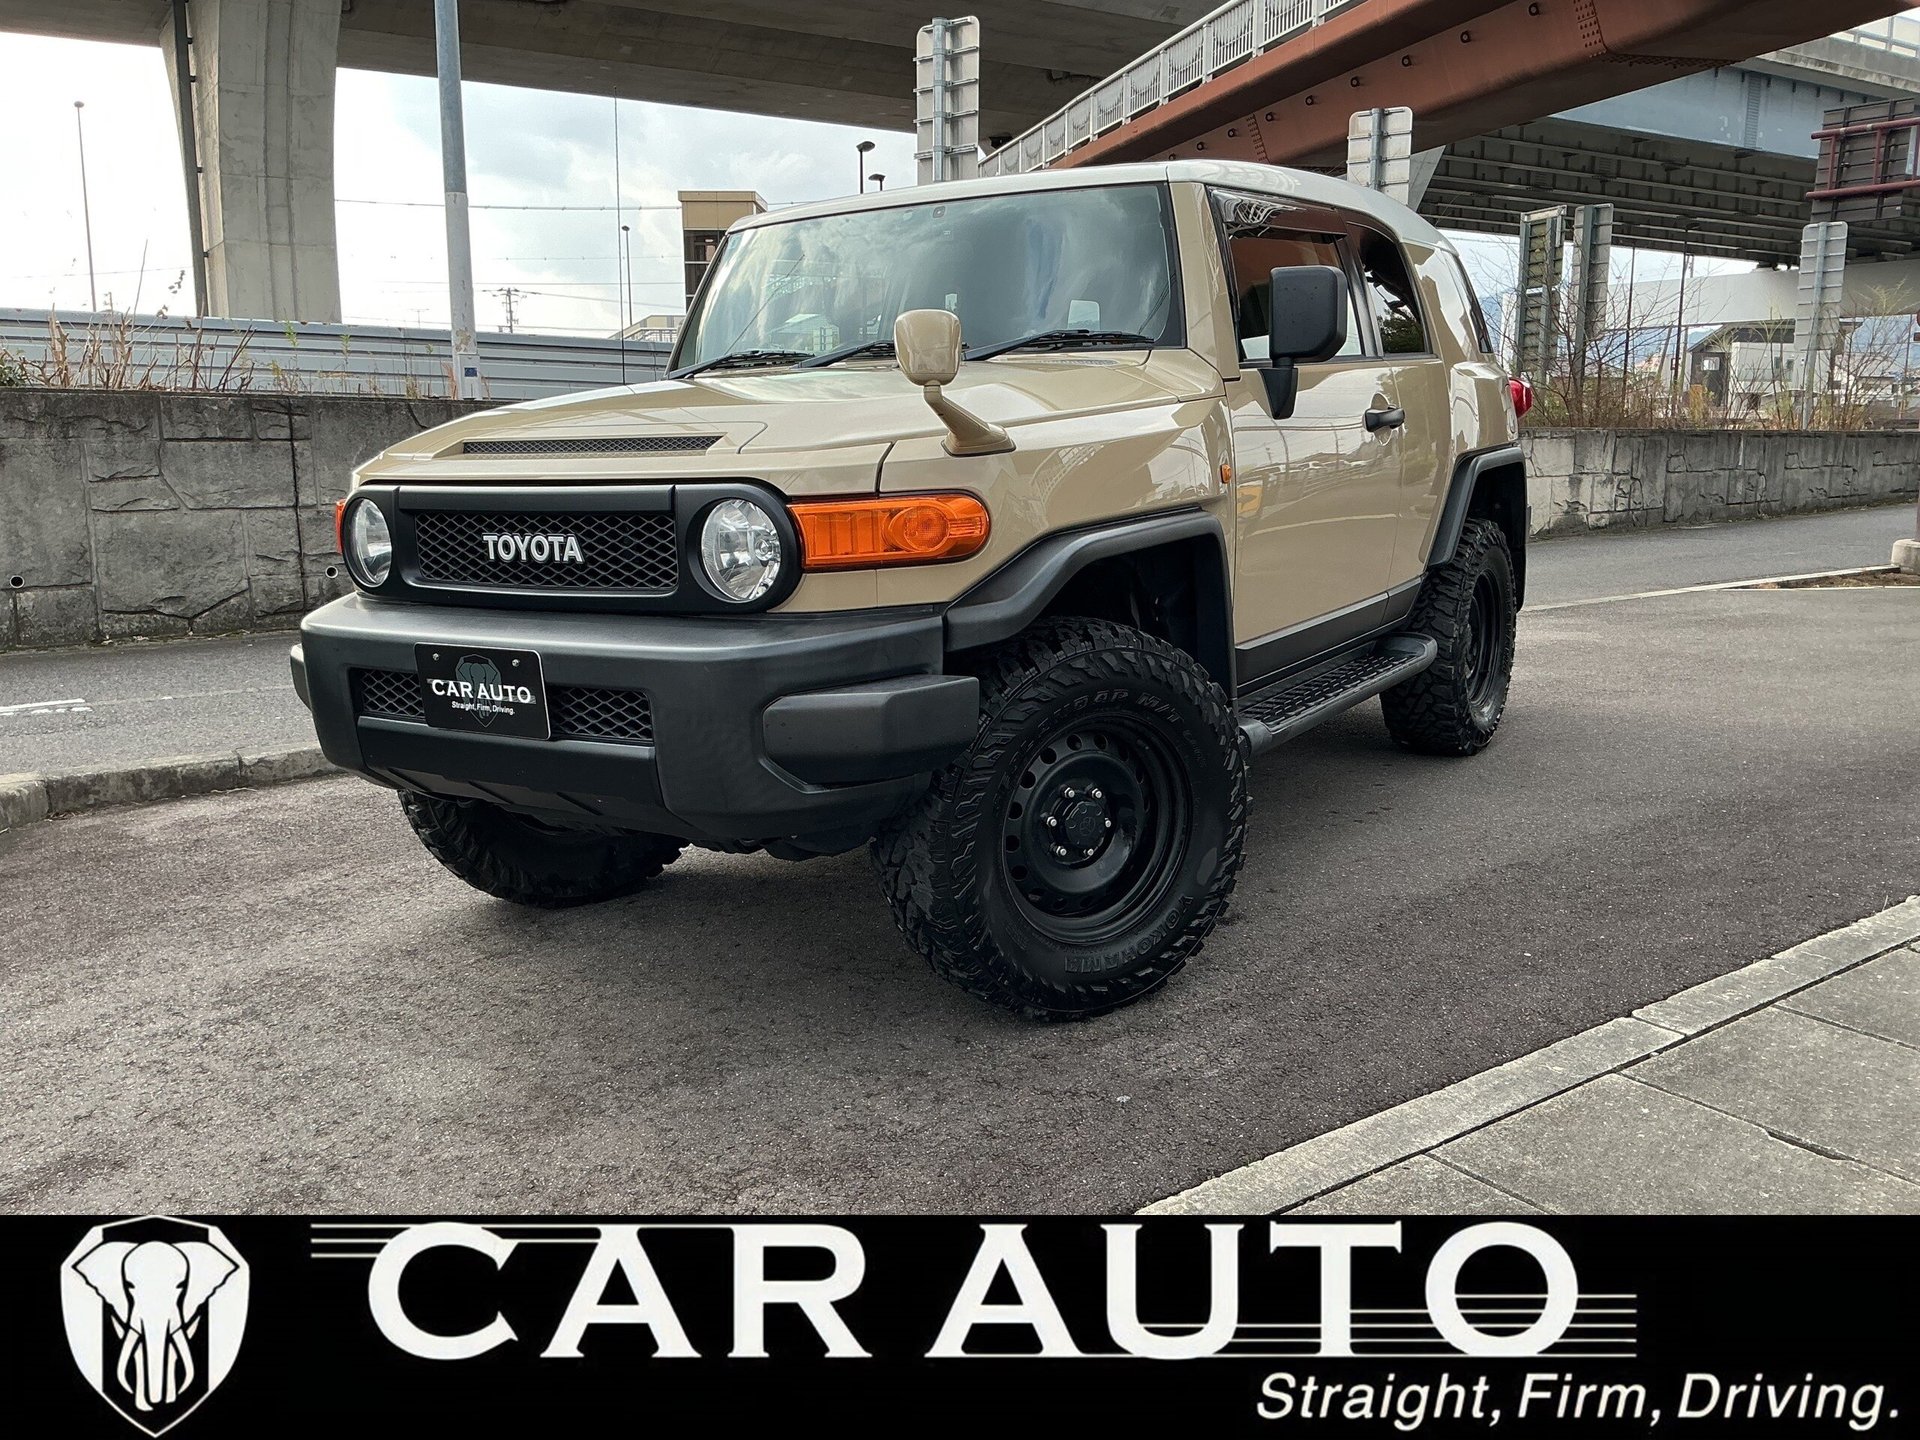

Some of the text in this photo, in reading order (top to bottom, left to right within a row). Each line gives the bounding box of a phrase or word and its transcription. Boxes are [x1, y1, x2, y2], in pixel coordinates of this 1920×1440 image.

[482, 533, 584, 563] TOYOTA
[431, 679, 531, 704] CAR AUTO
[1063, 893, 1197, 974] YOKOHAMA
